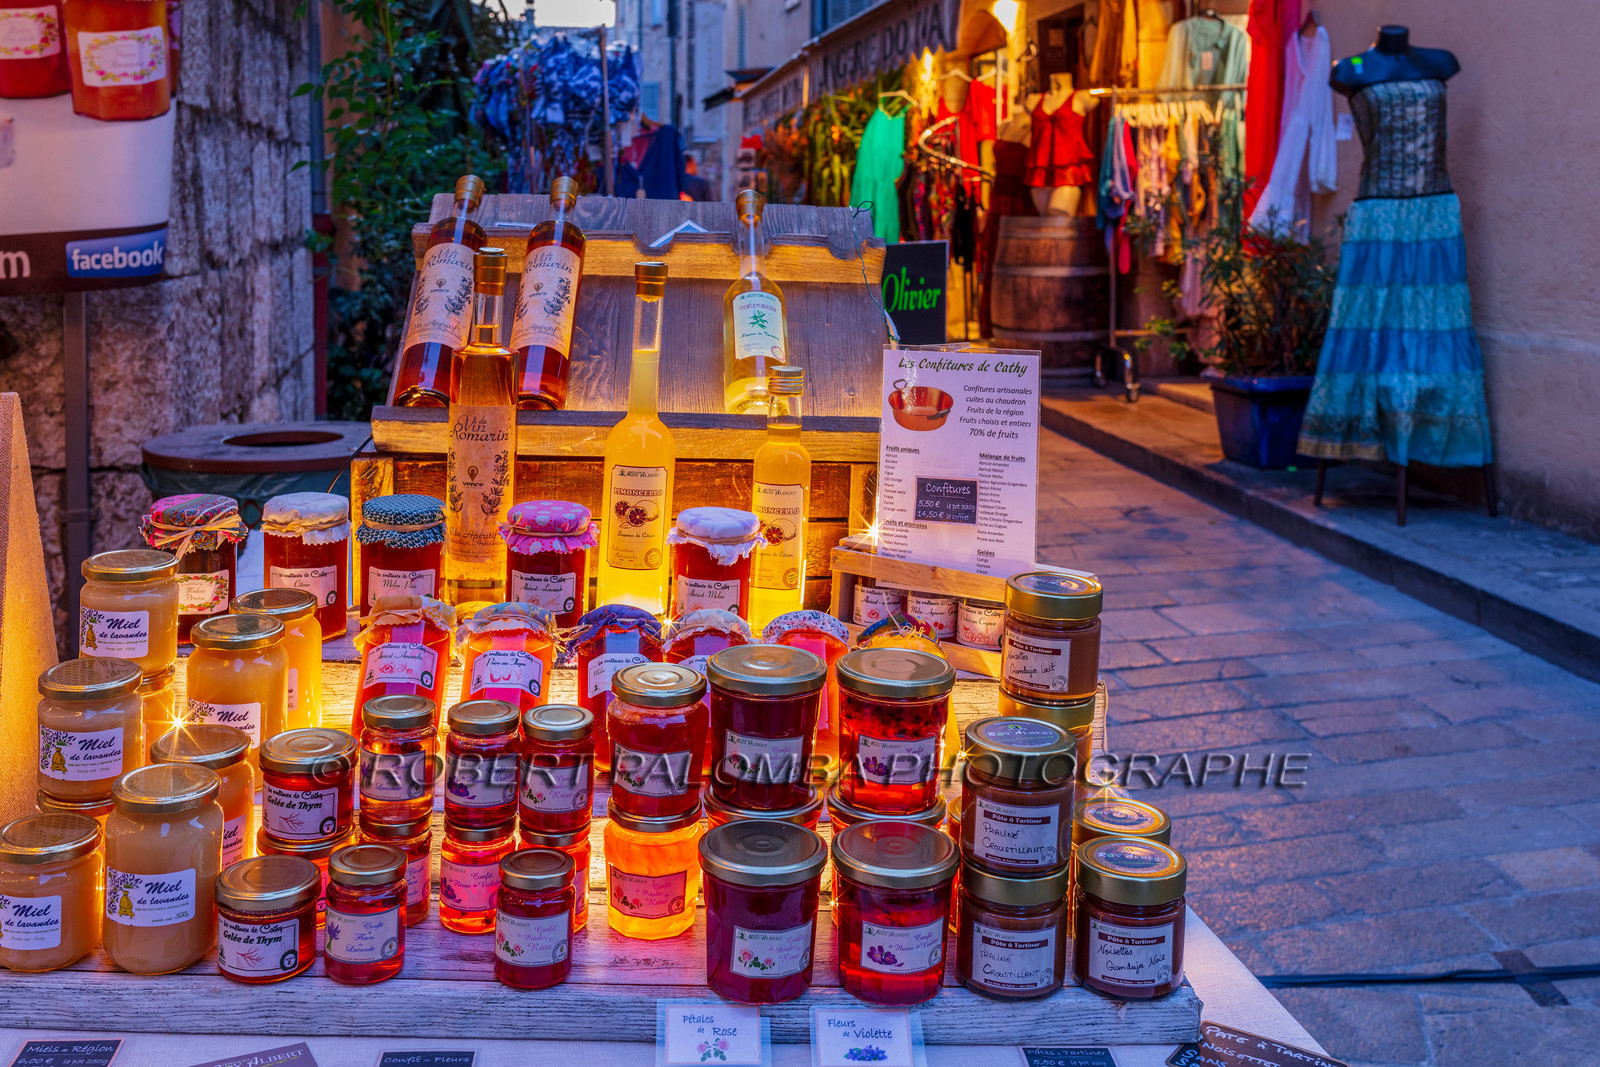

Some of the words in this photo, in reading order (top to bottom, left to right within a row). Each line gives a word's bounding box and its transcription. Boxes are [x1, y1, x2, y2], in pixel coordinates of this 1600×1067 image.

[71, 241, 164, 271] facebook
[882, 267, 941, 312] Olivier
[898, 357, 915, 368] Les
[919, 357, 974, 372] Confitures
[978, 359, 990, 371] de
[995, 361, 1028, 377] Cathy
[963, 384, 995, 394] Confitures
[996, 386, 1033, 395] artisanales
[965, 395, 984, 403] cuites
[995, 396, 1026, 405] chaudron
[967, 406, 985, 414] Fruits
[986, 407, 994, 415] de
[995, 407, 1002, 415] la
[1003, 407, 1024, 418] région
[457, 414, 486, 433] Vin
[959, 416, 977, 424] Fruits
[978, 417, 1000, 426] choisis
[1008, 419, 1032, 428] entiers
[450, 423, 509, 441] Romarin
[969, 428, 986, 437] 70%
[986, 429, 996, 438] de
[997, 429, 1019, 439] fruits
[926, 482, 971, 496] Confitures
[917, 499, 935, 508] 5,50
[935, 500, 941, 508] €
[917, 510, 938, 518] 14,50
[938, 511, 945, 519] €
[462, 528, 498, 540] Apéritif
[977, 549, 995, 557] Gelées
[184, 586, 206, 594] Melon
[106, 618, 141, 629] Miel
[110, 630, 147, 639] lavandes
[1013, 641, 1024, 650] Pâte
[1029, 646, 1053, 654] Tartiner
[216, 710, 249, 723] Miel
[78, 736, 115, 751] Miel
[69, 753, 81, 761] de
[83, 749, 122, 761] lavandes
[301, 790, 323, 800] Cathy
[267, 795, 285, 807] Gelée
[285, 800, 297, 809] de
[297, 801, 323, 812] Thym
[992, 813, 1008, 822] Pâte
[470, 871, 493, 880] Confit
[145, 879, 183, 894] Miel
[136, 897, 147, 905] de
[149, 893, 190, 905] lavandes
[12, 904, 52, 917] Miel
[4, 918, 15, 927] de
[16, 918, 60, 928] lavandes
[260, 924, 283, 934] Cathy
[223, 930, 243, 943] Gelée
[243, 935, 255, 944] de
[256, 936, 282, 946] Thym
[990, 939, 1007, 948] Pâte
[1107, 935, 1124, 944] Pâte
[345, 943, 376, 953] Lavande
[1096, 943, 1133, 956] Noisettes
[682, 1014, 714, 1024] Pétales
[827, 1018, 856, 1028] Fleurs
[697, 1026, 705, 1034] de
[712, 1026, 738, 1037] Rose
[853, 1028, 893, 1040] Violette
[26, 1044, 60, 1053] Miels
[72, 1044, 114, 1055] Région
[247, 1049, 304, 1067] ALBERT
[384, 1055, 421, 1064] Confit
